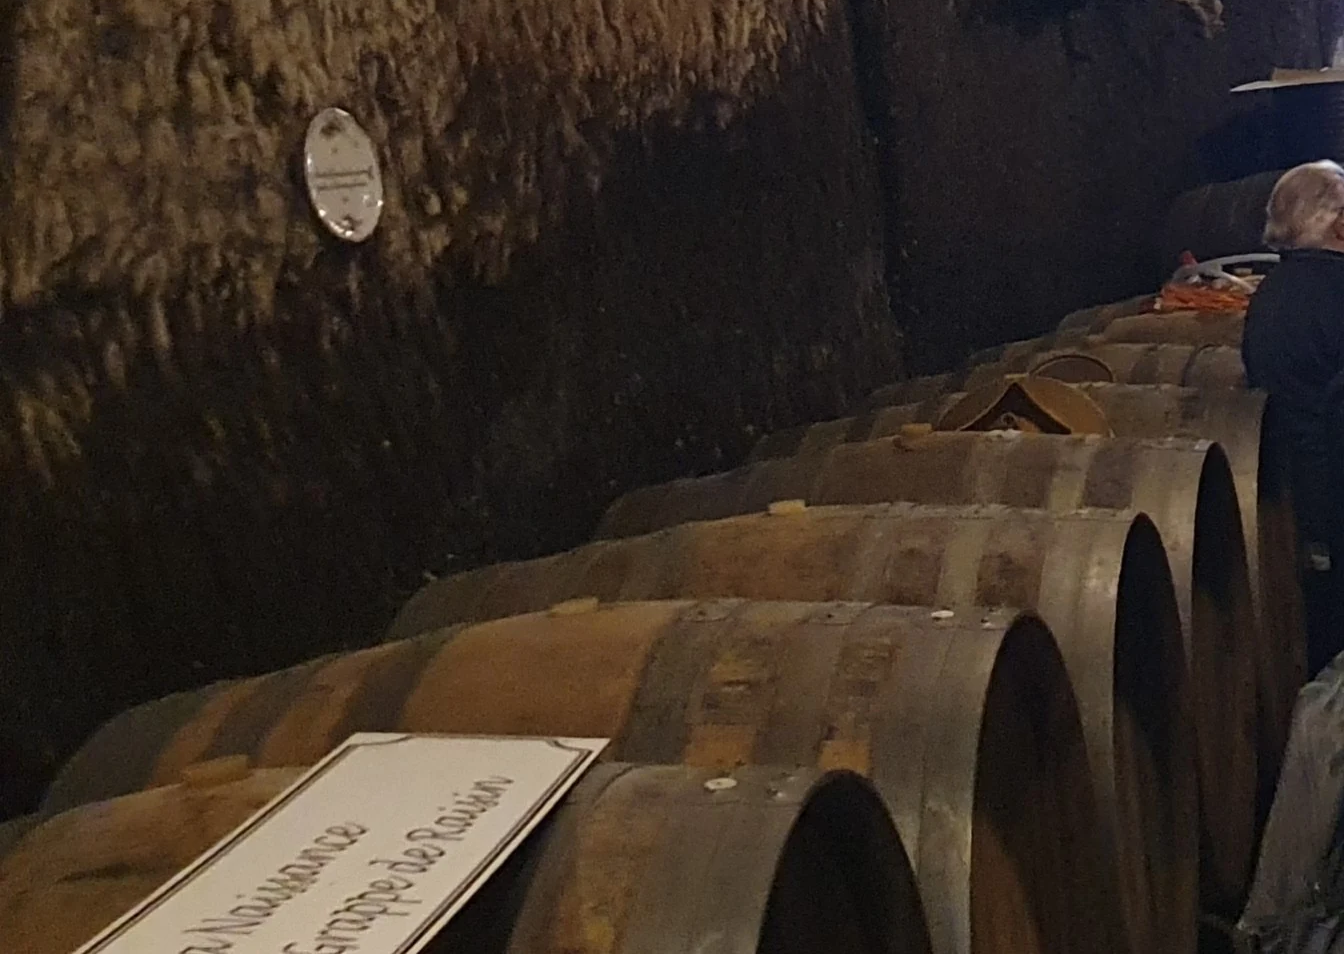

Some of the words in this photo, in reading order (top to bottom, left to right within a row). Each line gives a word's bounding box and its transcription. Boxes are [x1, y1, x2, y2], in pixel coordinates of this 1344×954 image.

[405, 775, 515, 842] Raisin
[181, 820, 370, 936] Naissance
[368, 843, 446, 876] de
